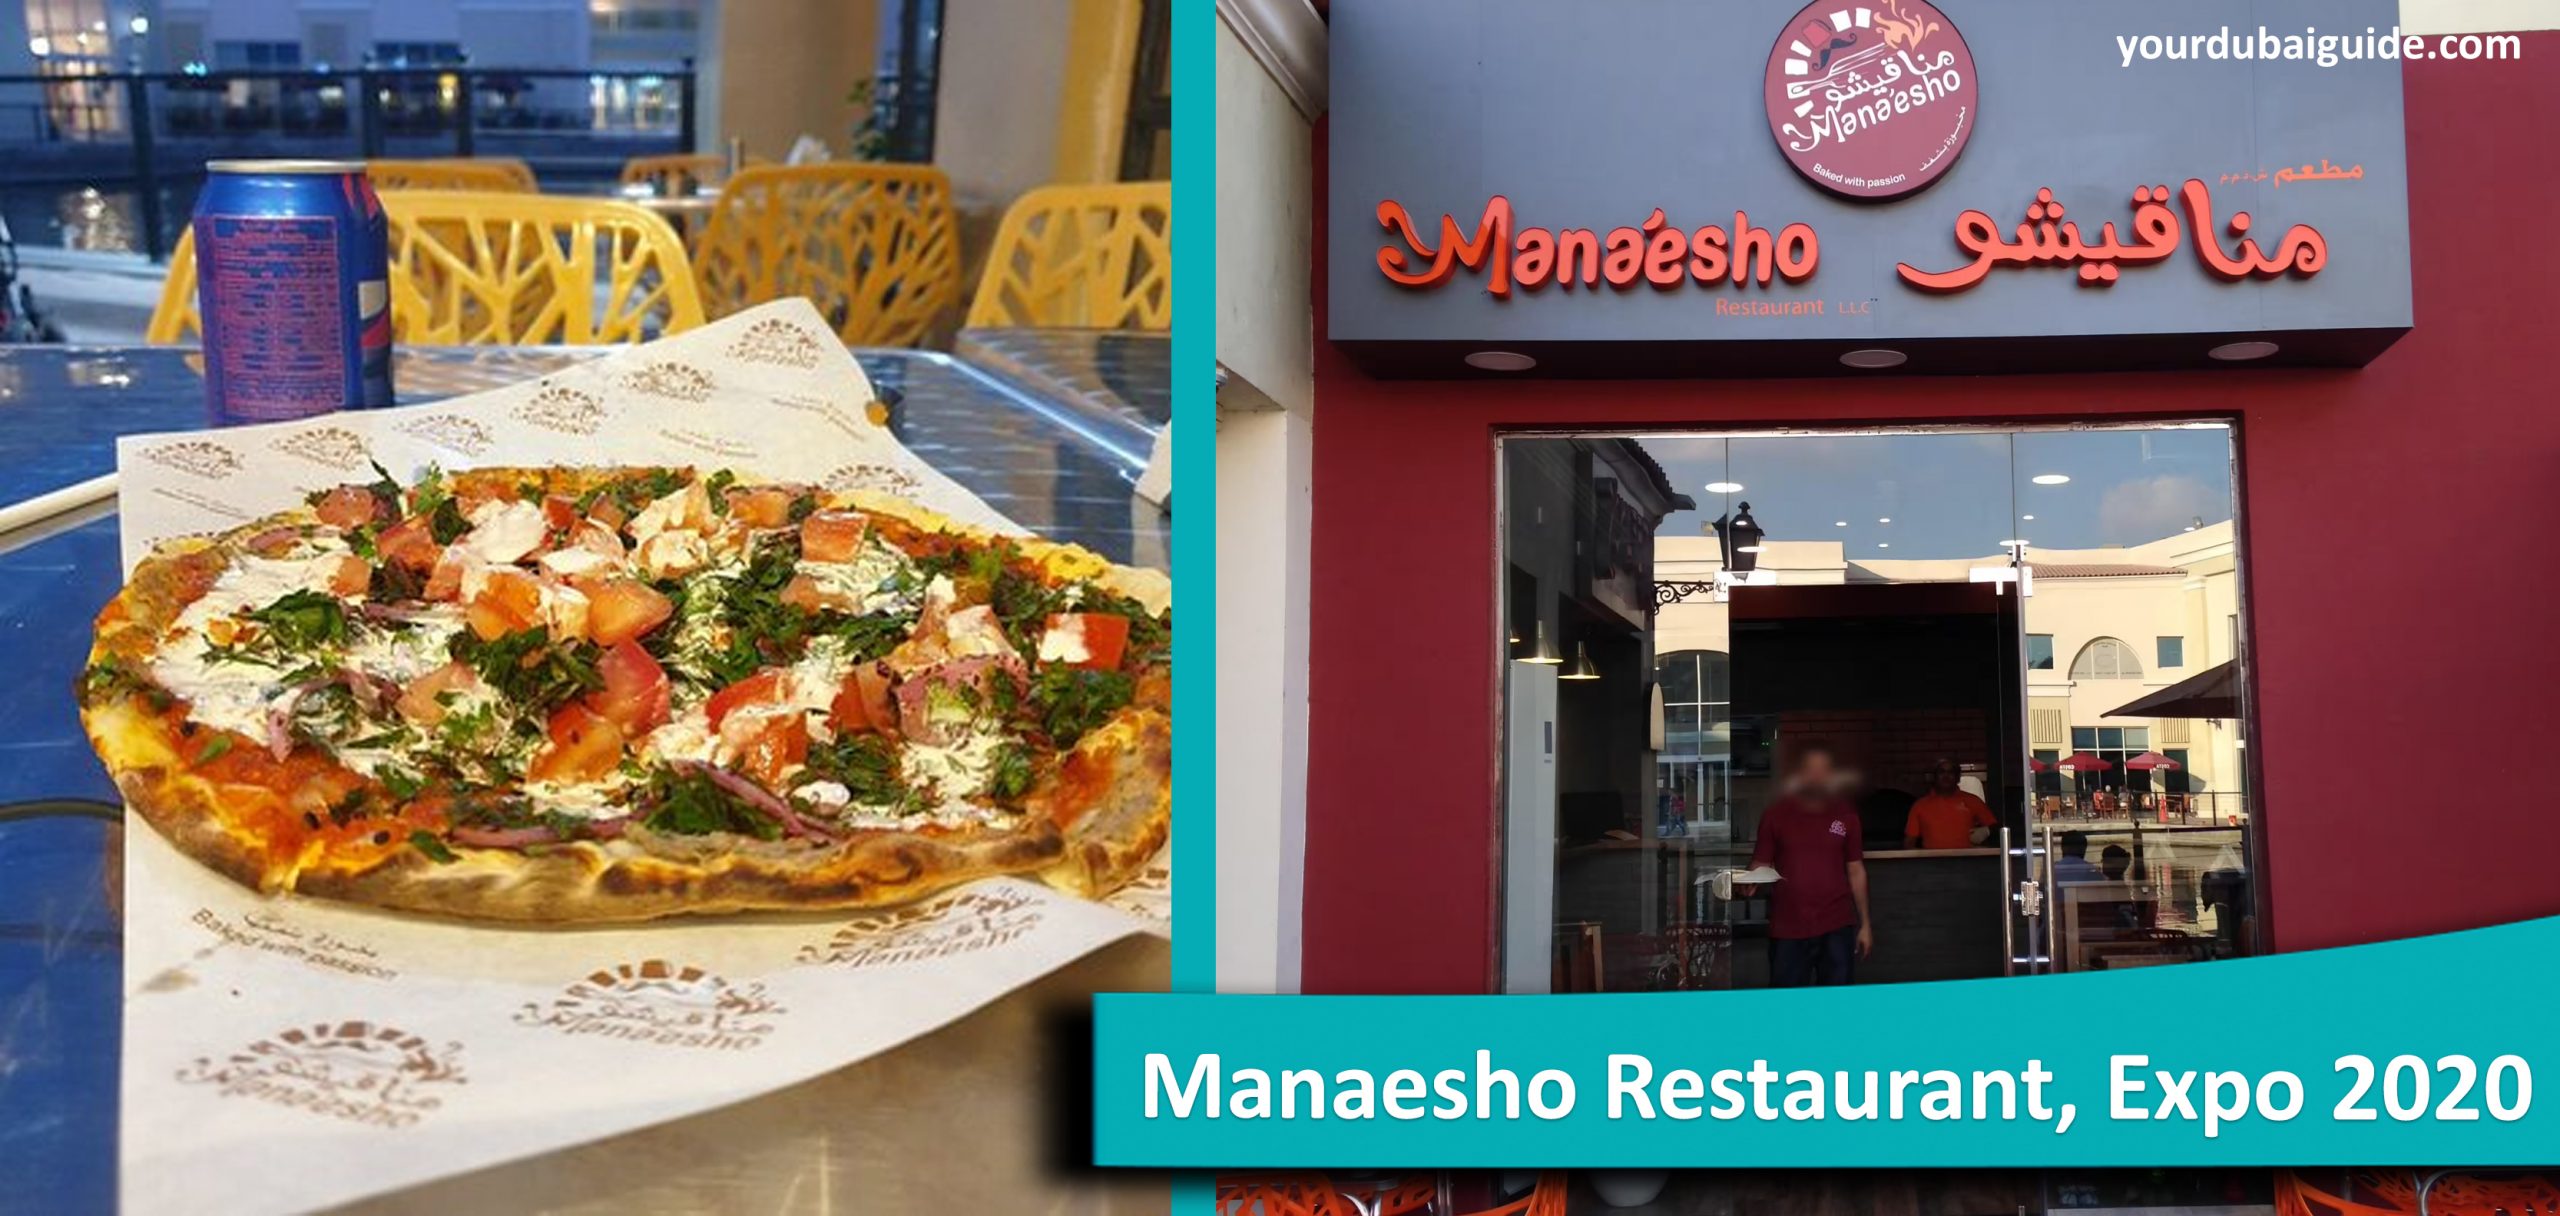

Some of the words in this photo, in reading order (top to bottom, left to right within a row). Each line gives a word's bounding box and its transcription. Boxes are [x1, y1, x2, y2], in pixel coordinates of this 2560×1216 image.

[1812, 162, 1843, 184] Baked
[1844, 178, 1865, 187] with
[1867, 172, 1906, 188] passion
[2274, 159, 2364, 189] مطعم
[1716, 298, 1824, 316] Restaurant
